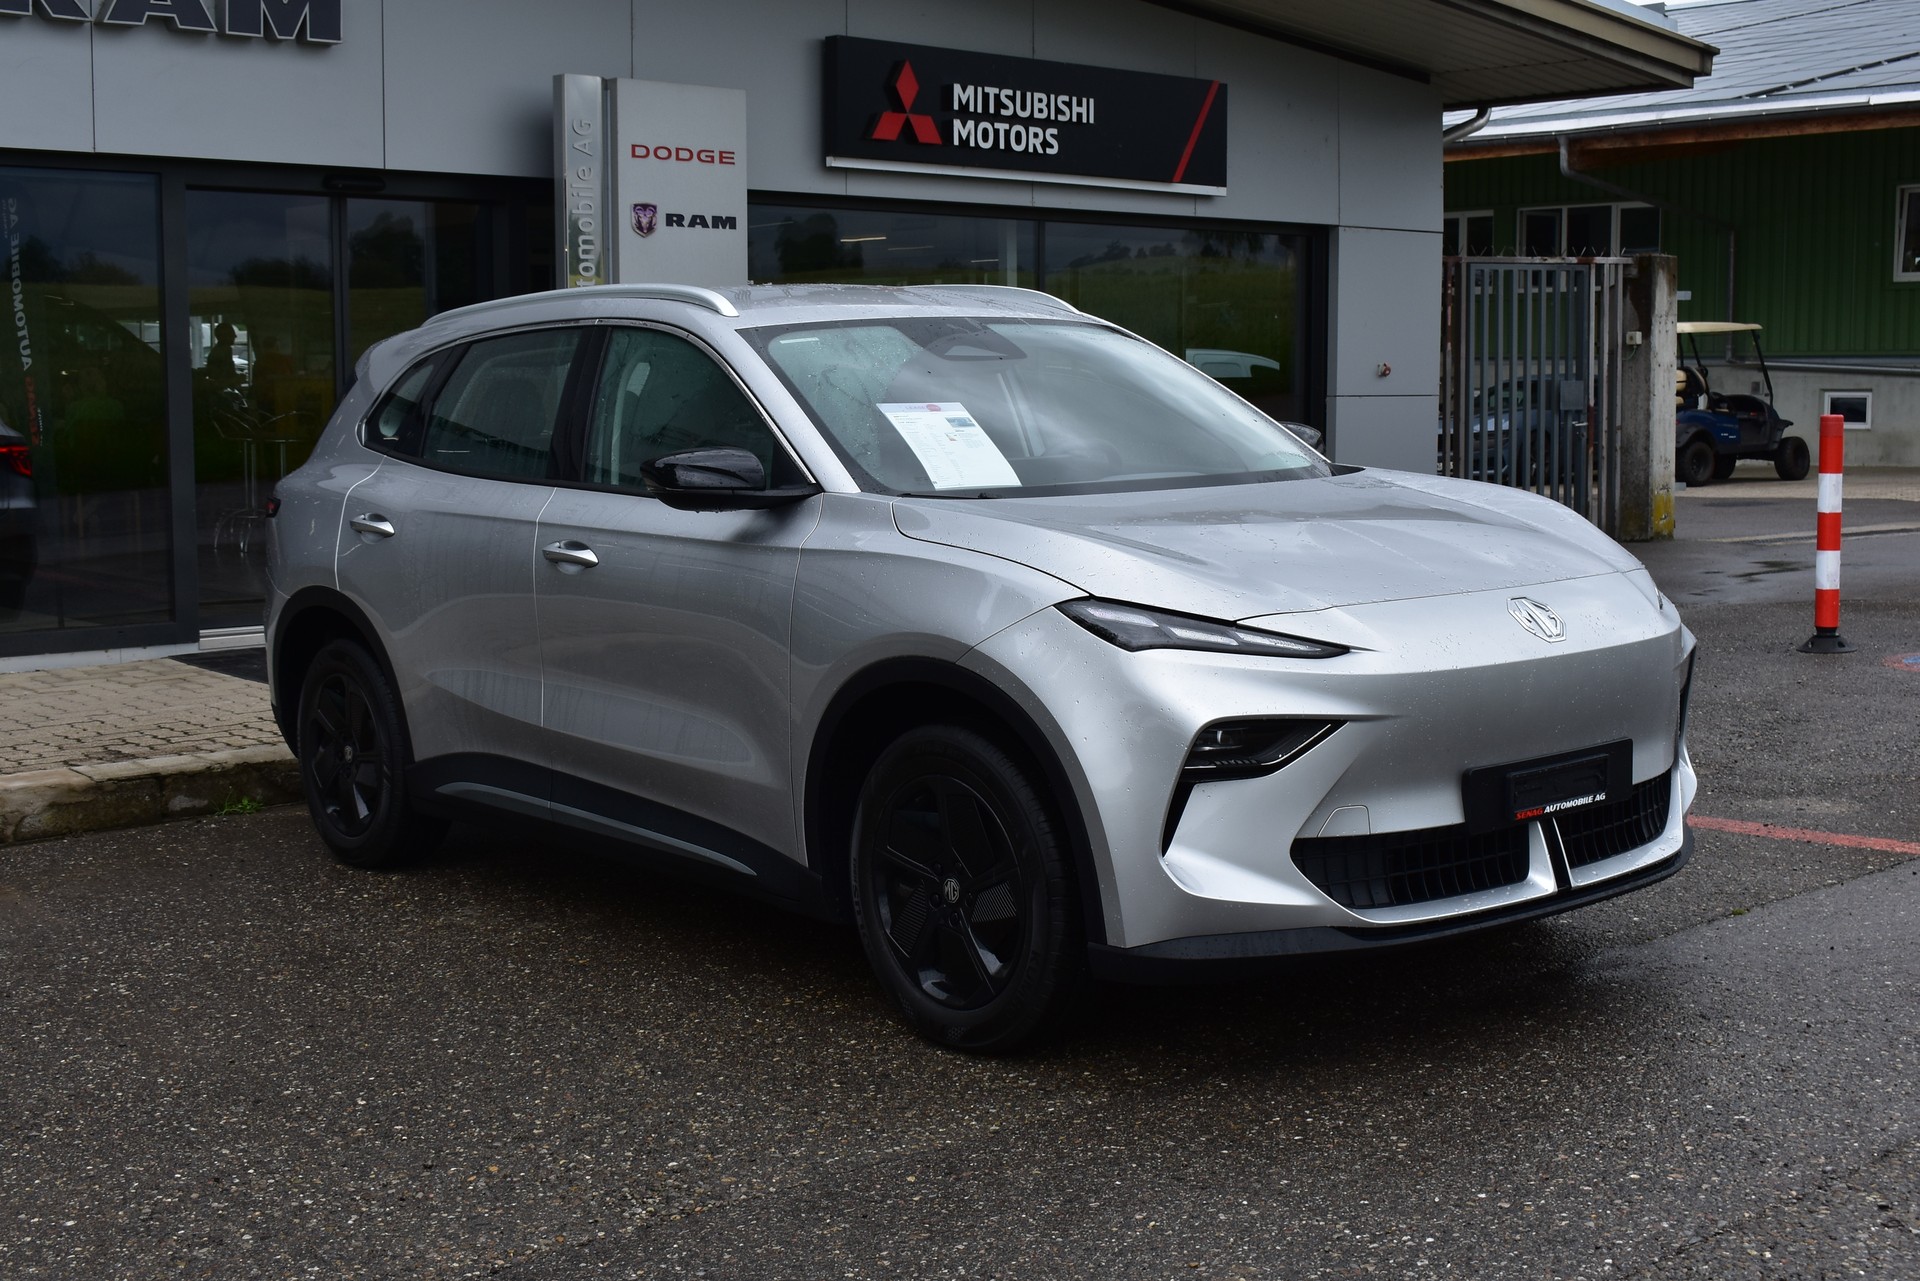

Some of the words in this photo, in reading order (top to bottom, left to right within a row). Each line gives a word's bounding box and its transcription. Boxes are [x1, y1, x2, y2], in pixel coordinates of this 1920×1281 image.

[953, 83, 1095, 124] MITSUBISHI
[572, 119, 593, 157] AG
[953, 118, 1059, 155] MOTORS
[631, 144, 735, 165] DODGE
[665, 213, 737, 230] RAM
[1507, 597, 1566, 642] MG
[1516, 808, 1543, 820] SENAG
[1544, 795, 1594, 814] AUTOMOBILE
[1594, 792, 1606, 803] AG
[943, 878, 960, 903] MG
